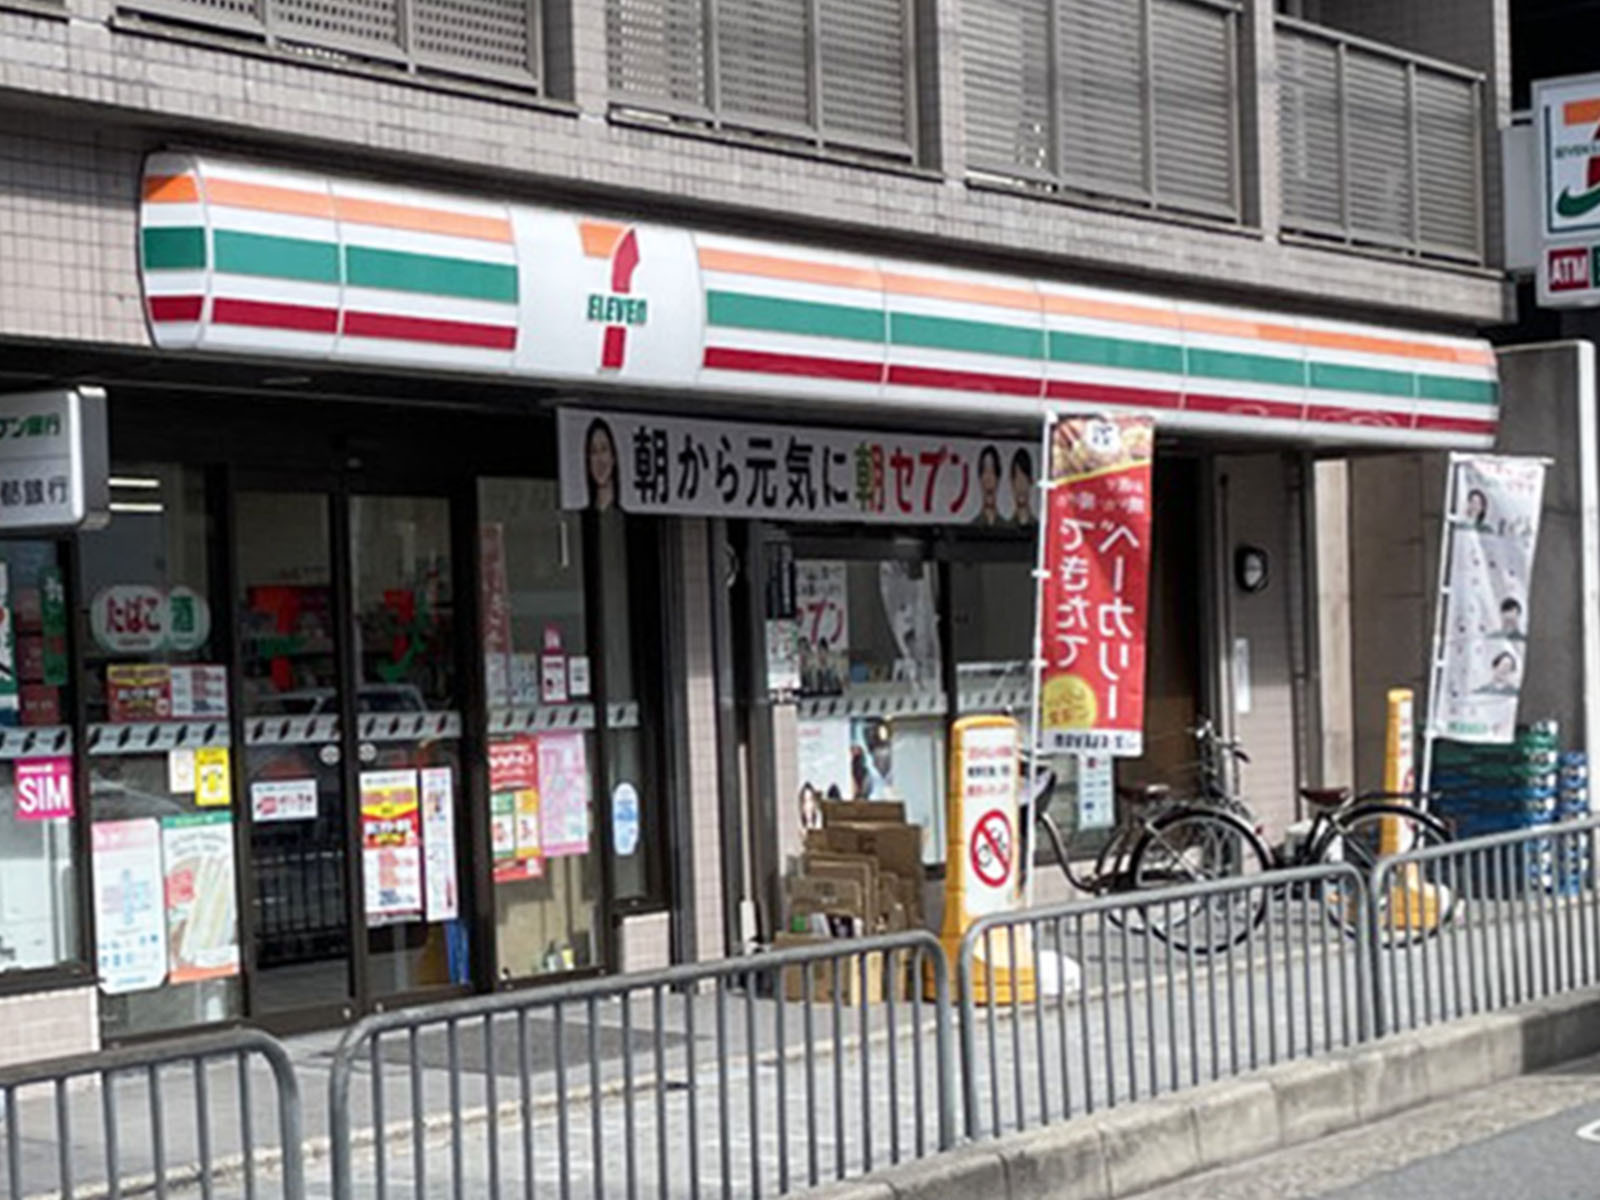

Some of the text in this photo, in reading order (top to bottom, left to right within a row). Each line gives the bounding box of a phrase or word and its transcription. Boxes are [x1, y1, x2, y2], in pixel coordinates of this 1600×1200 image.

[1552, 255, 1588, 284] ATM
[632, 425, 970, 514] 朝から元気に朝セブン
[18, 775, 71, 813] SIM
